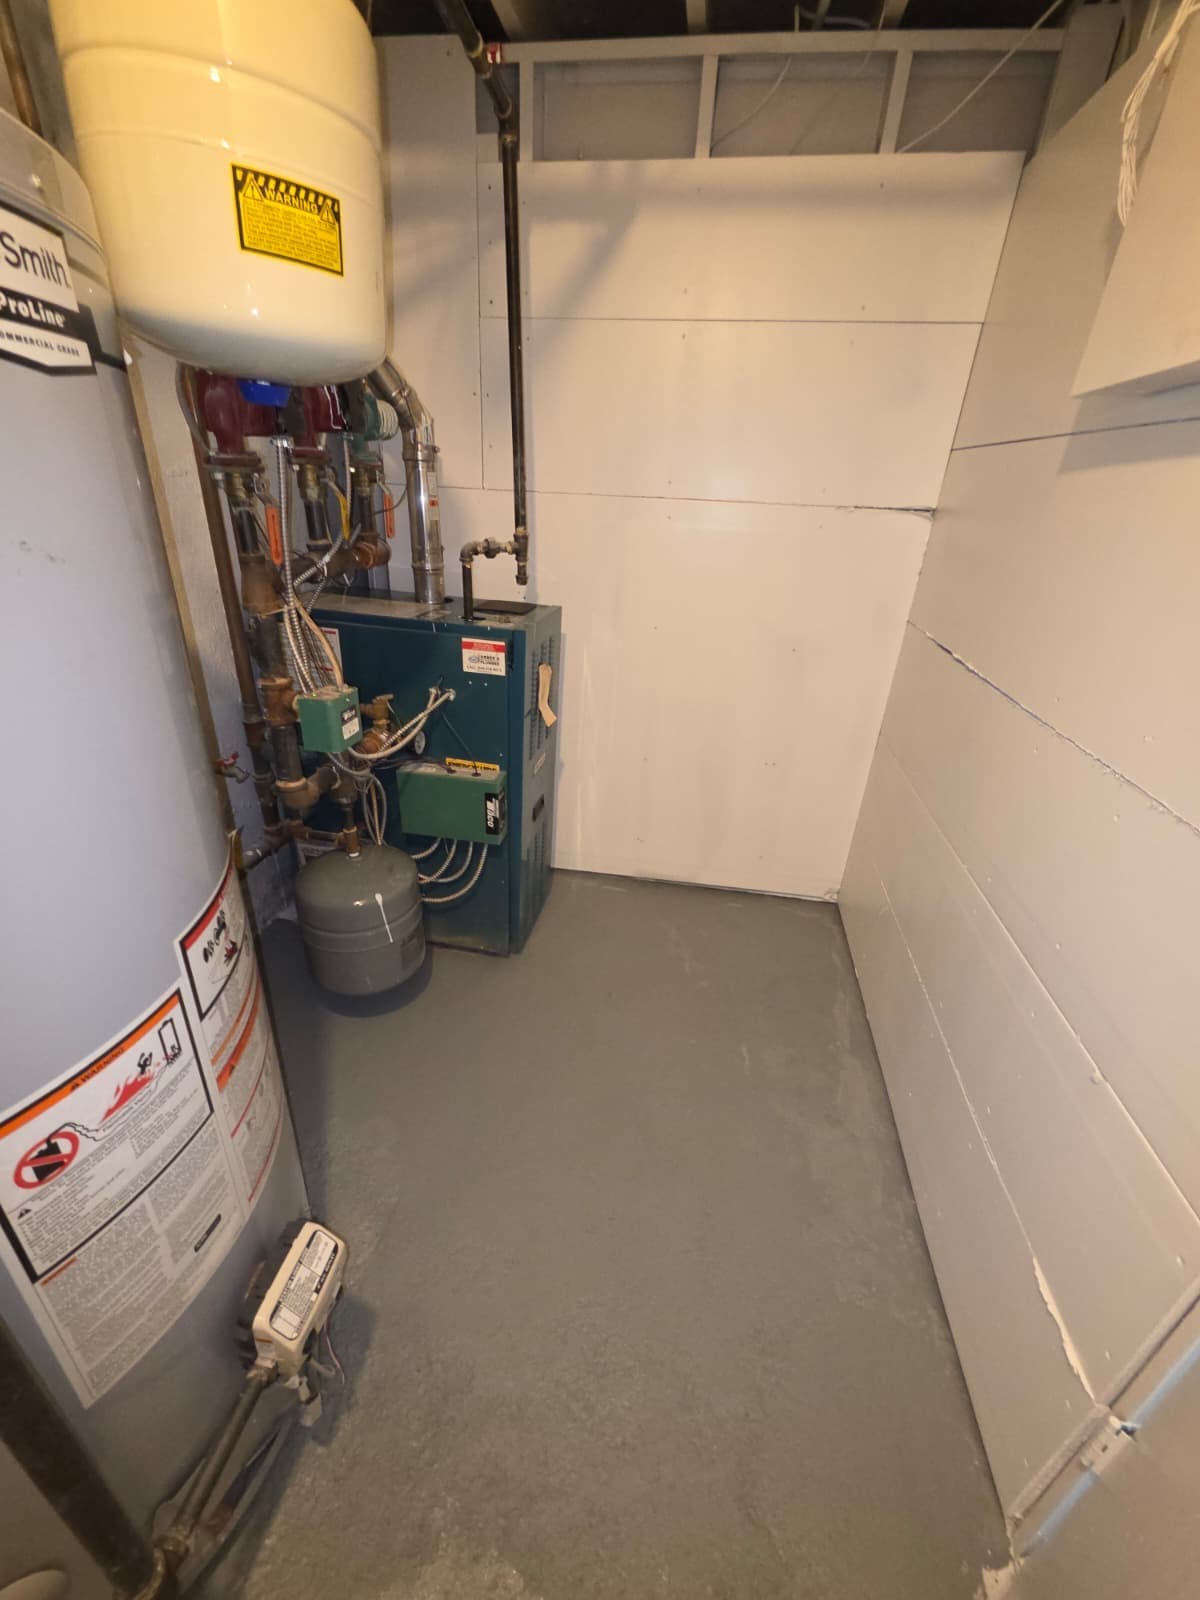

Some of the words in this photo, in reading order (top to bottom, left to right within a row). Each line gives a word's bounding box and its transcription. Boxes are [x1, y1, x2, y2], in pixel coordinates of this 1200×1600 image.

[265, 186, 319, 216] WARNING
[0, 231, 69, 288] Smith
[0, 331, 54, 351] OMMERCIAL
